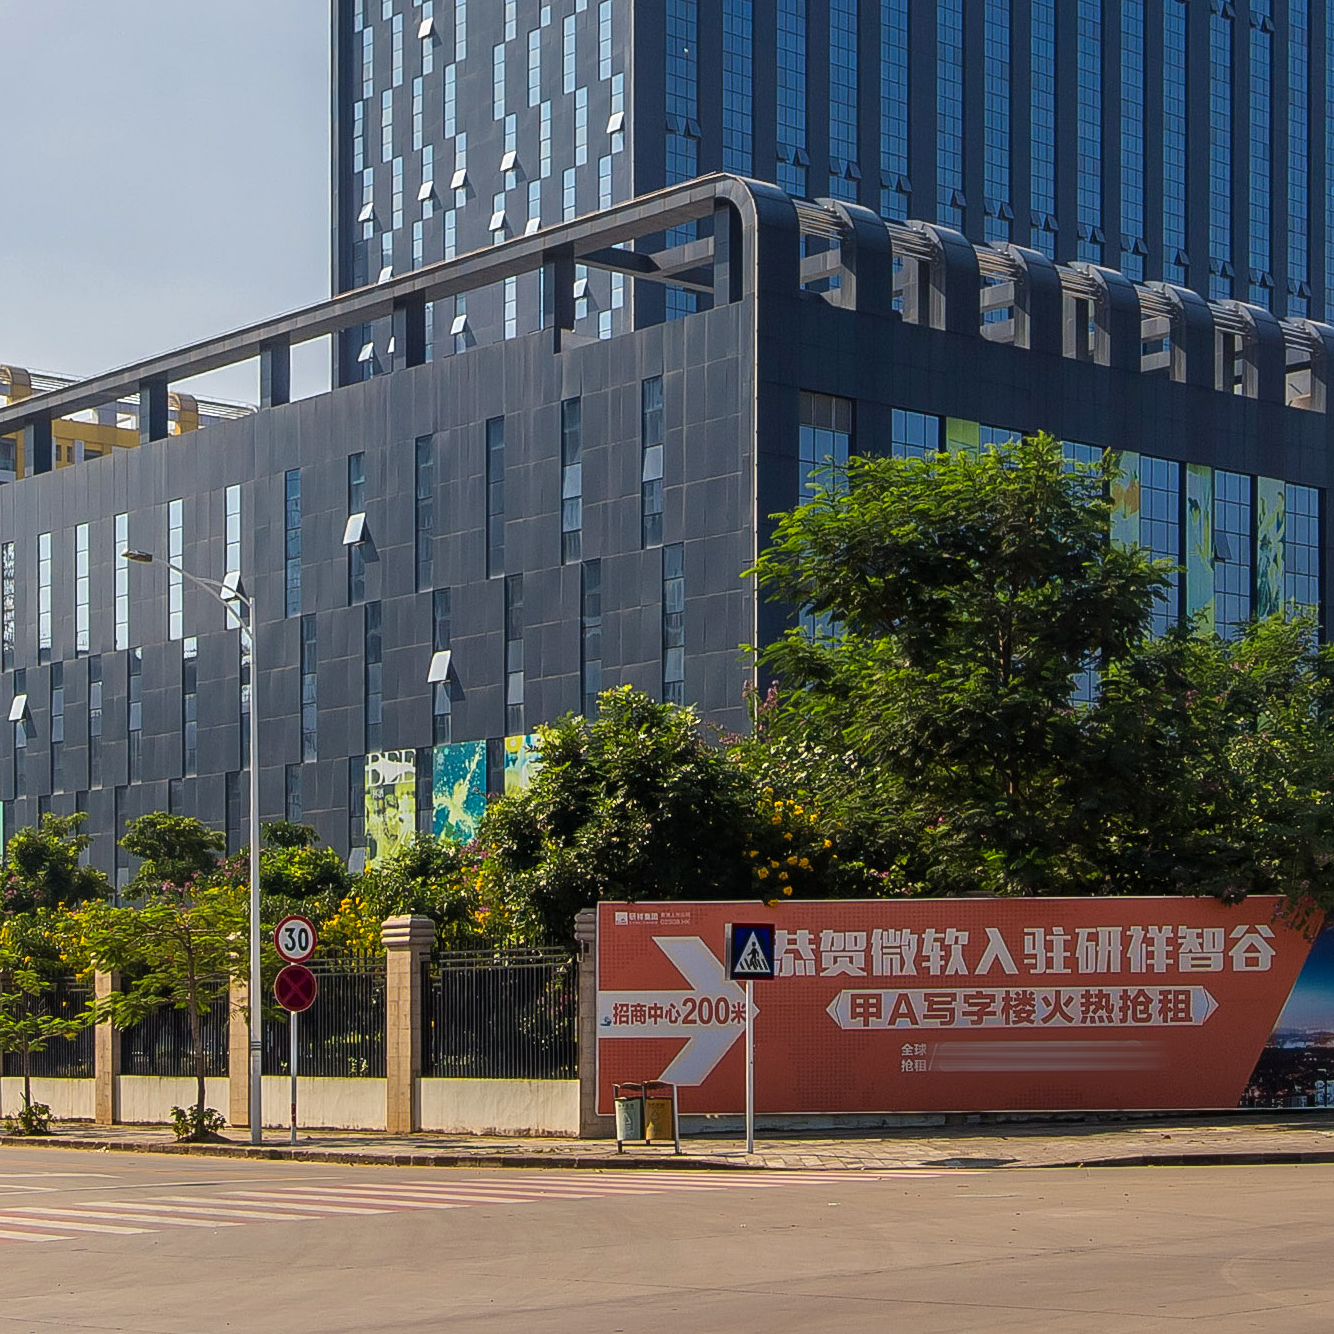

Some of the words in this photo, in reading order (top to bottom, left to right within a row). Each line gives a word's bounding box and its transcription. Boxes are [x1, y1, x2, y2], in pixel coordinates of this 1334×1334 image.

[284, 928, 309, 952] 30
[774, 924, 1277, 978] 恭贺微软入驻研祥智谷
[613, 997, 746, 1025] 招商中心200米
[849, 988, 1193, 1028] 甲A写字楼火热抢租
[901, 1043, 927, 1057] 全球
[901, 1059, 927, 1072] 抢租
